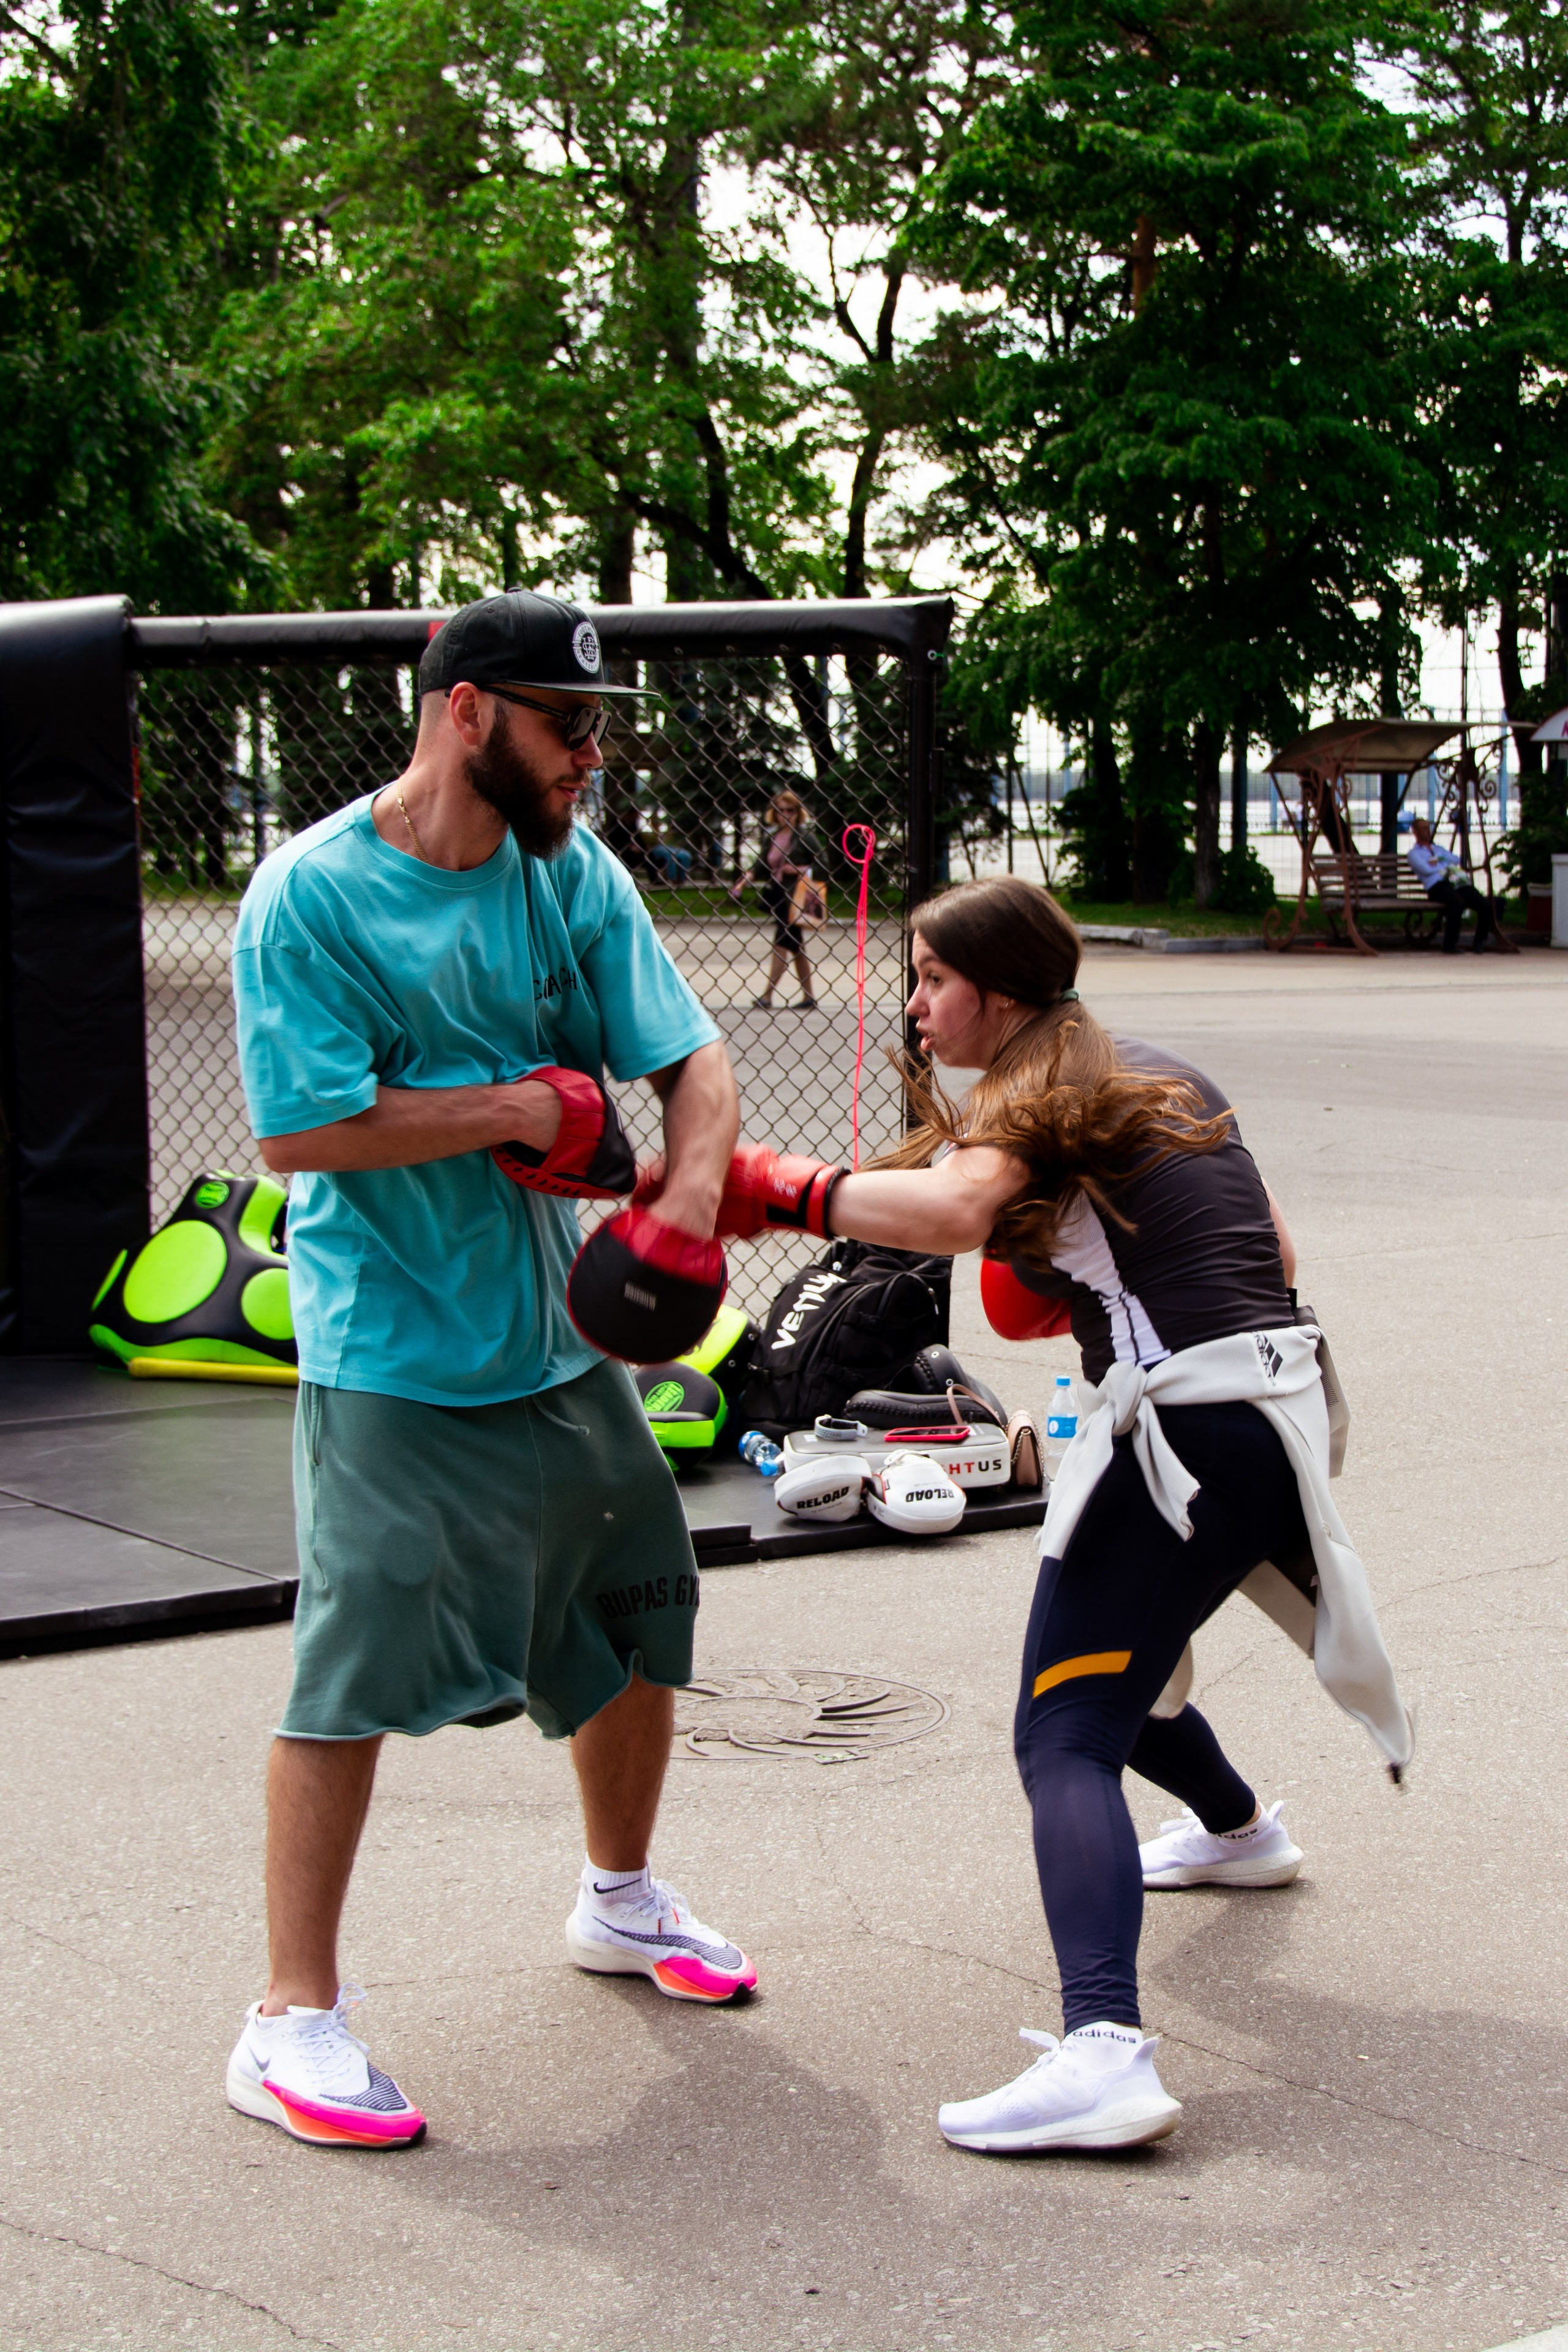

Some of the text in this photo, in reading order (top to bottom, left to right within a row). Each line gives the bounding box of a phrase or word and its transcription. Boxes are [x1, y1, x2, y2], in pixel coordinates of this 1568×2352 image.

[942, 1459, 1002, 1475] HTUS
[797, 1486, 850, 1509] RELOAD
[906, 1488, 954, 1502] RELOAD
[596, 1577, 668, 1619] BUPAS
[1073, 2029, 1136, 2044] adidas
